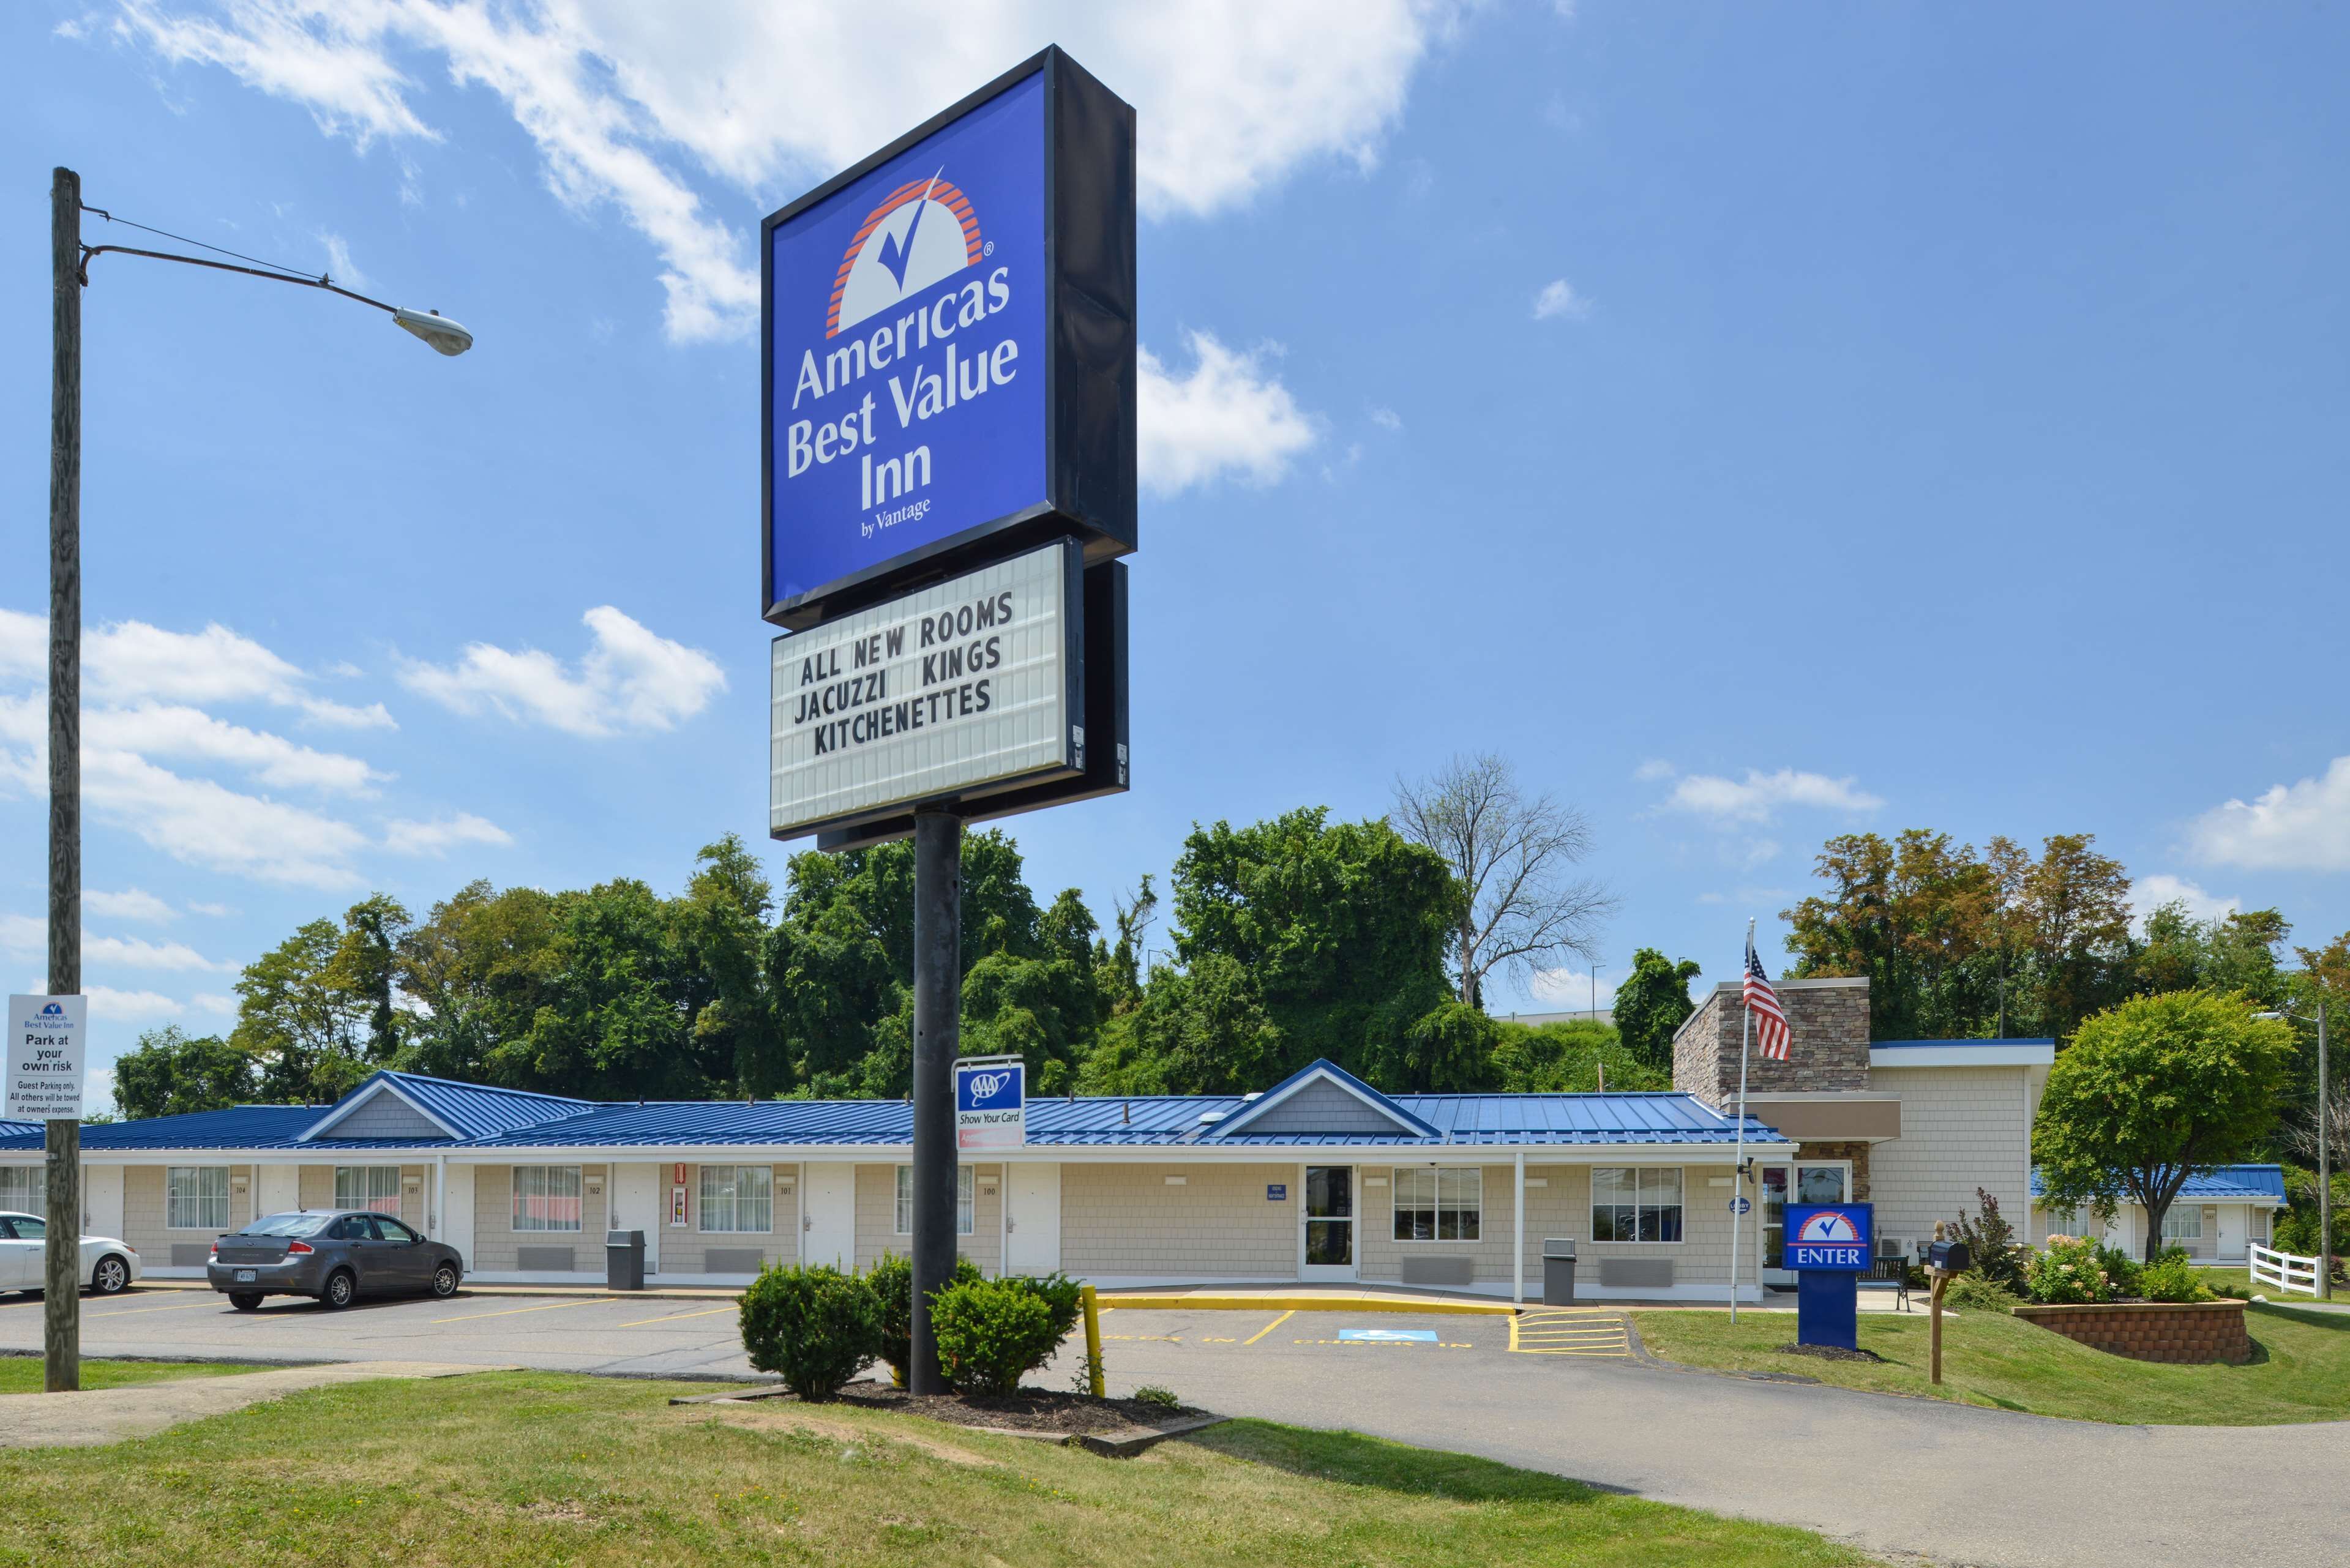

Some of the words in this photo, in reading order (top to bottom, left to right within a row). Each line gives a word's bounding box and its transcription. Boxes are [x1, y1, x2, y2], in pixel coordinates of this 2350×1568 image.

[791, 266, 1010, 410] Americas
[788, 390, 876, 478] Best
[888, 338, 1019, 429] Value
[861, 445, 931, 510] Inn
[862, 523, 874, 539] by
[875, 499, 930, 529] Vantage
[801, 648, 840, 686] ALL
[855, 625, 904, 669] NEW
[921, 591, 1012, 648] ROOMS
[795, 670, 885, 723] JACUZZI
[923, 636, 1000, 686] KINGS
[815, 679, 990, 756] KITCHENETTES
[26, 1034, 54, 1045] Park
[58, 1036, 68, 1045] at
[37, 1050, 62, 1061] your
[18, 1081, 38, 1089] Guest
[40, 1082, 61, 1091] Parking
[63, 1081, 75, 1091] only.
[22, 1062, 49, 1071] own
[53, 1061, 72, 1071] risk
[960, 1113, 981, 1124] Show
[984, 1114, 1000, 1122] Your
[1001, 1111, 1019, 1122] Card
[1798, 1249, 1860, 1263] ENTER
